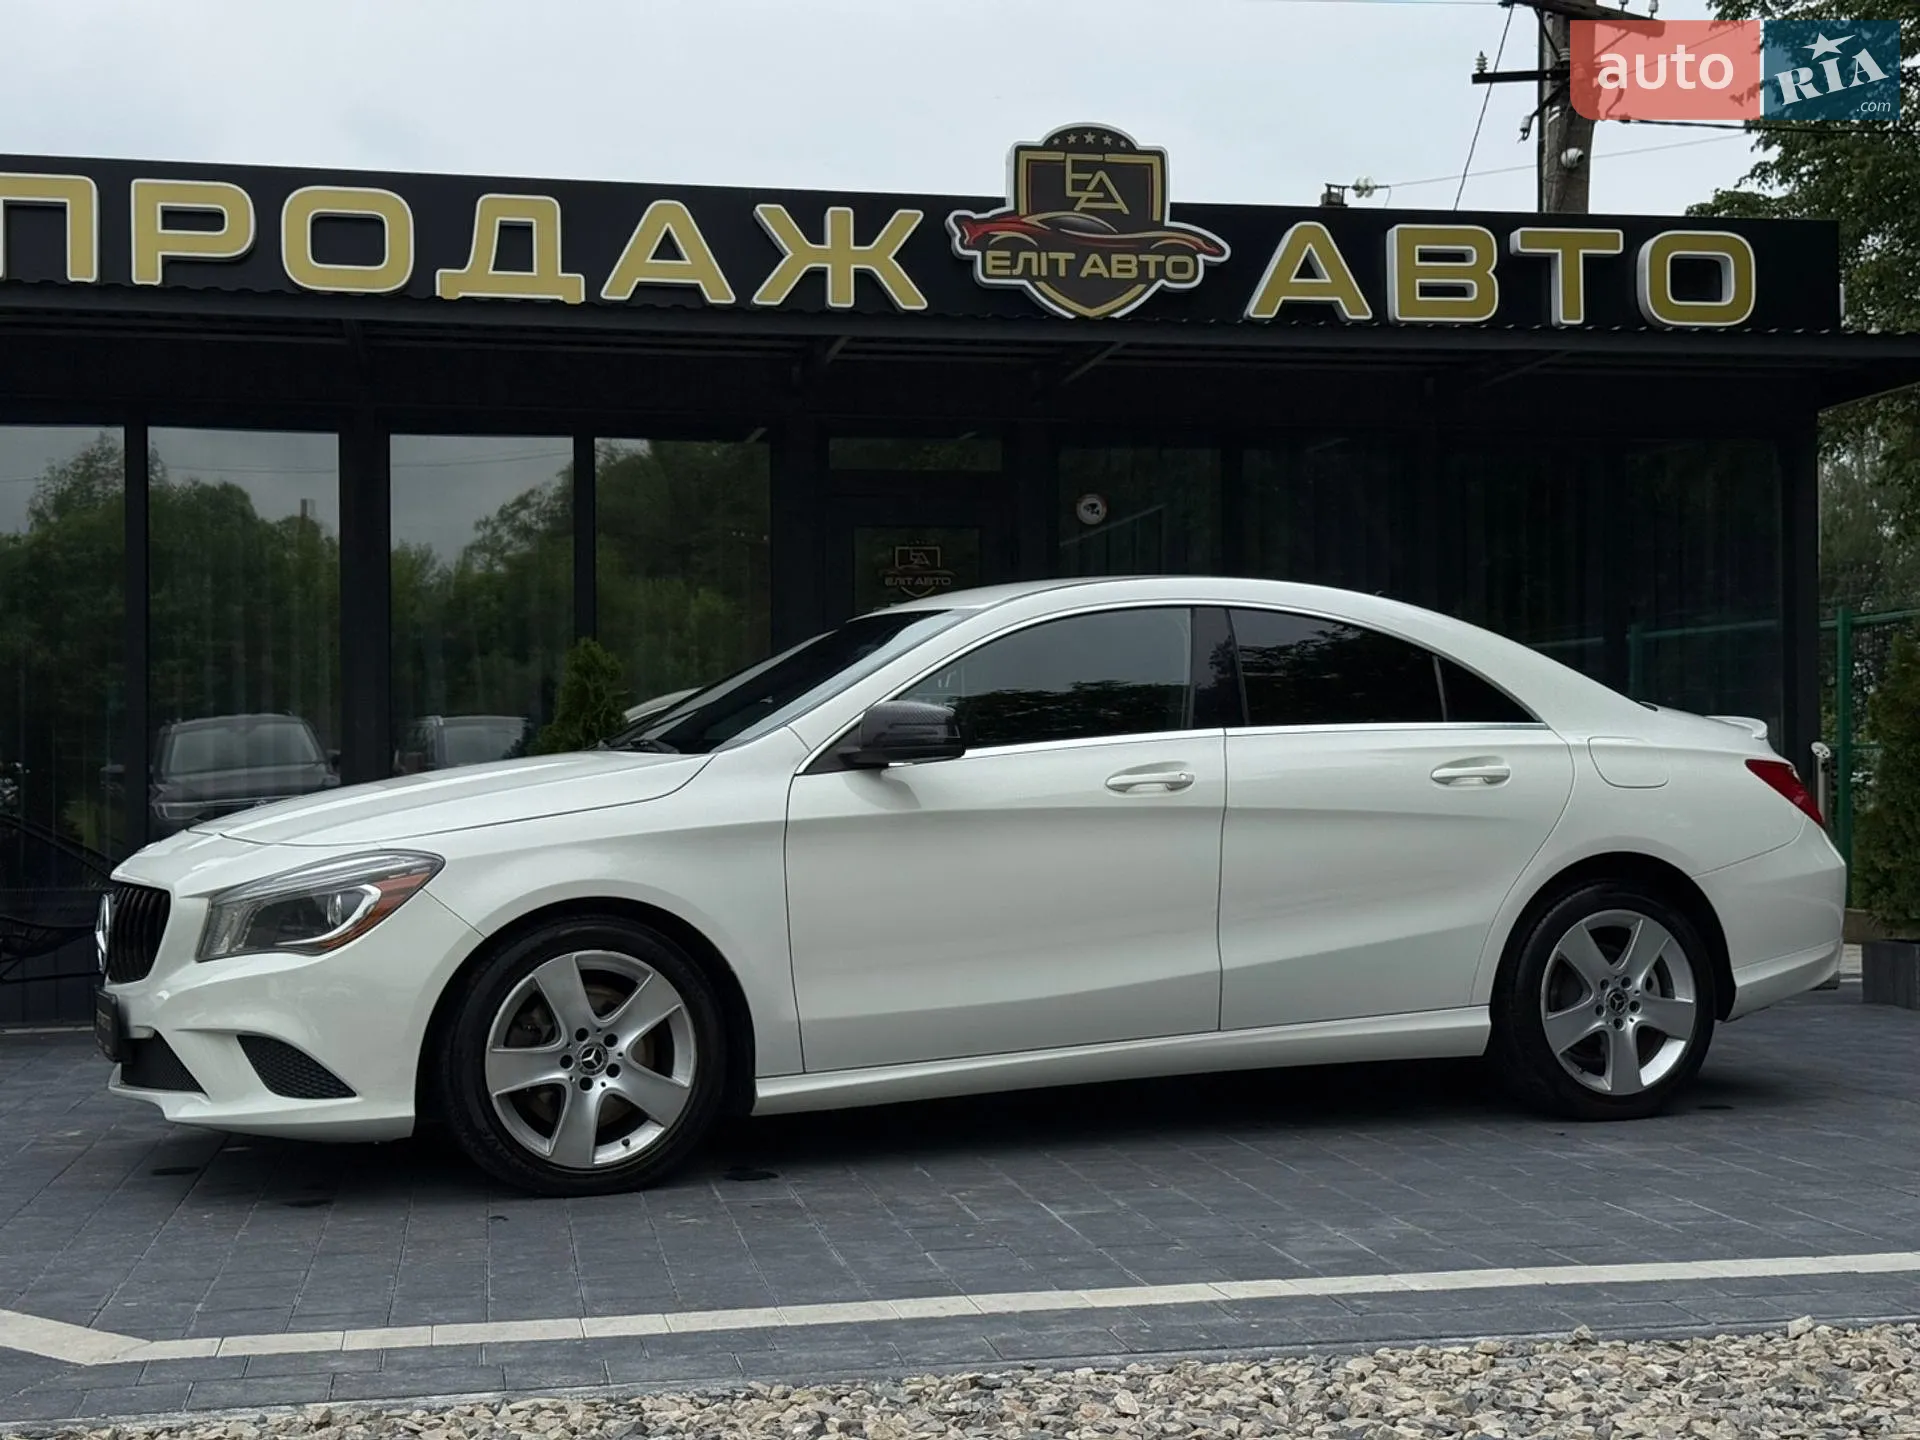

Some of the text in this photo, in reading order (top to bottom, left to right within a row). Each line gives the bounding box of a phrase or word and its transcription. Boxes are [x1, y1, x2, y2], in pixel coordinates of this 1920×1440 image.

[0, 172, 1757, 327] ПРОДАЖ АВТО
[985, 249, 1195, 281] ЕЛІТ АВТО
